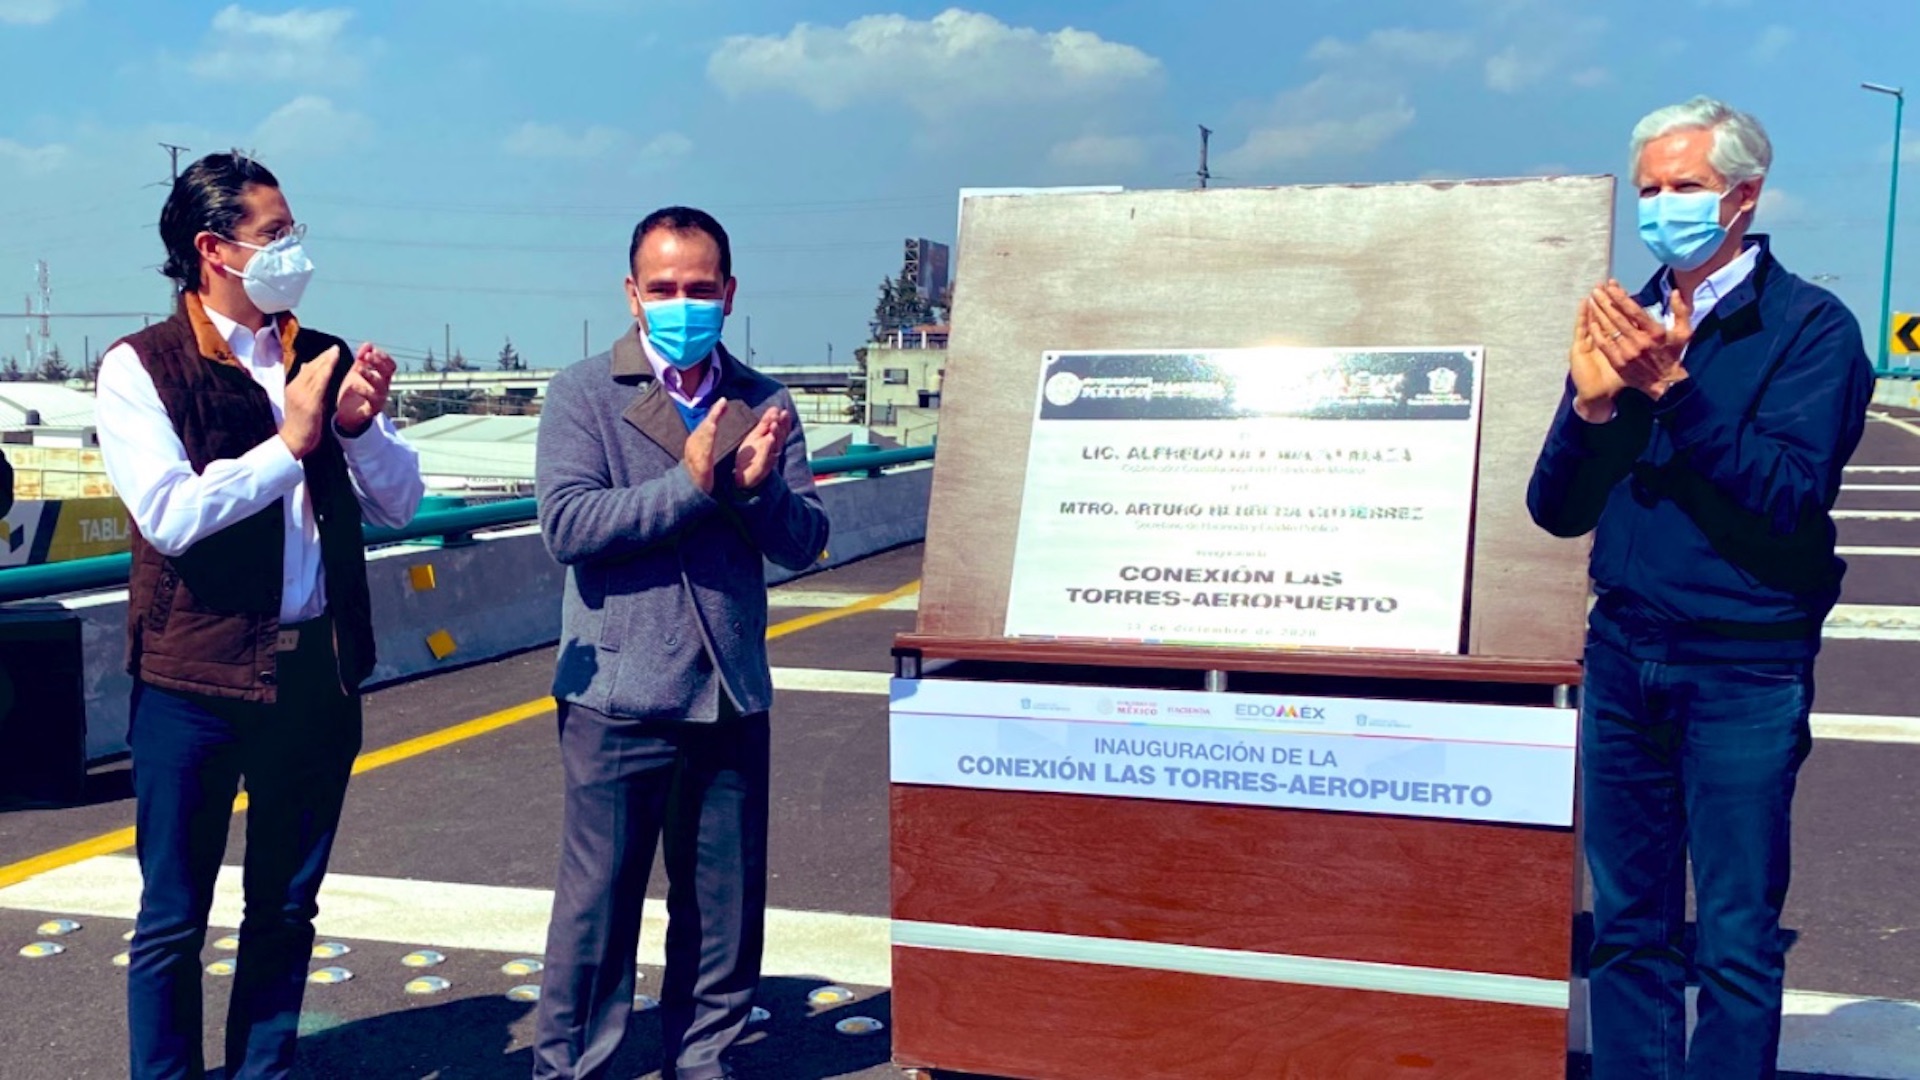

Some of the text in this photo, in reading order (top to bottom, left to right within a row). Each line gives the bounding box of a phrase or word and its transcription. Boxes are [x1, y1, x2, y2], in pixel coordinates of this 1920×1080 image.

[1081, 445, 1119, 460] LIC.
[1060, 501, 1118, 516] MTRO.
[1125, 502, 1203, 516] ARTURO
[1119, 564, 1343, 587] CONEXIÓN LAS
[1066, 587, 1398, 613] TORRES-AEROPUERTO
[1094, 737, 1338, 767] INAUGURACIÓN DE LA
[957, 755, 1493, 807] CONEXIÓN LAS TORRES-AEROPUERTO
